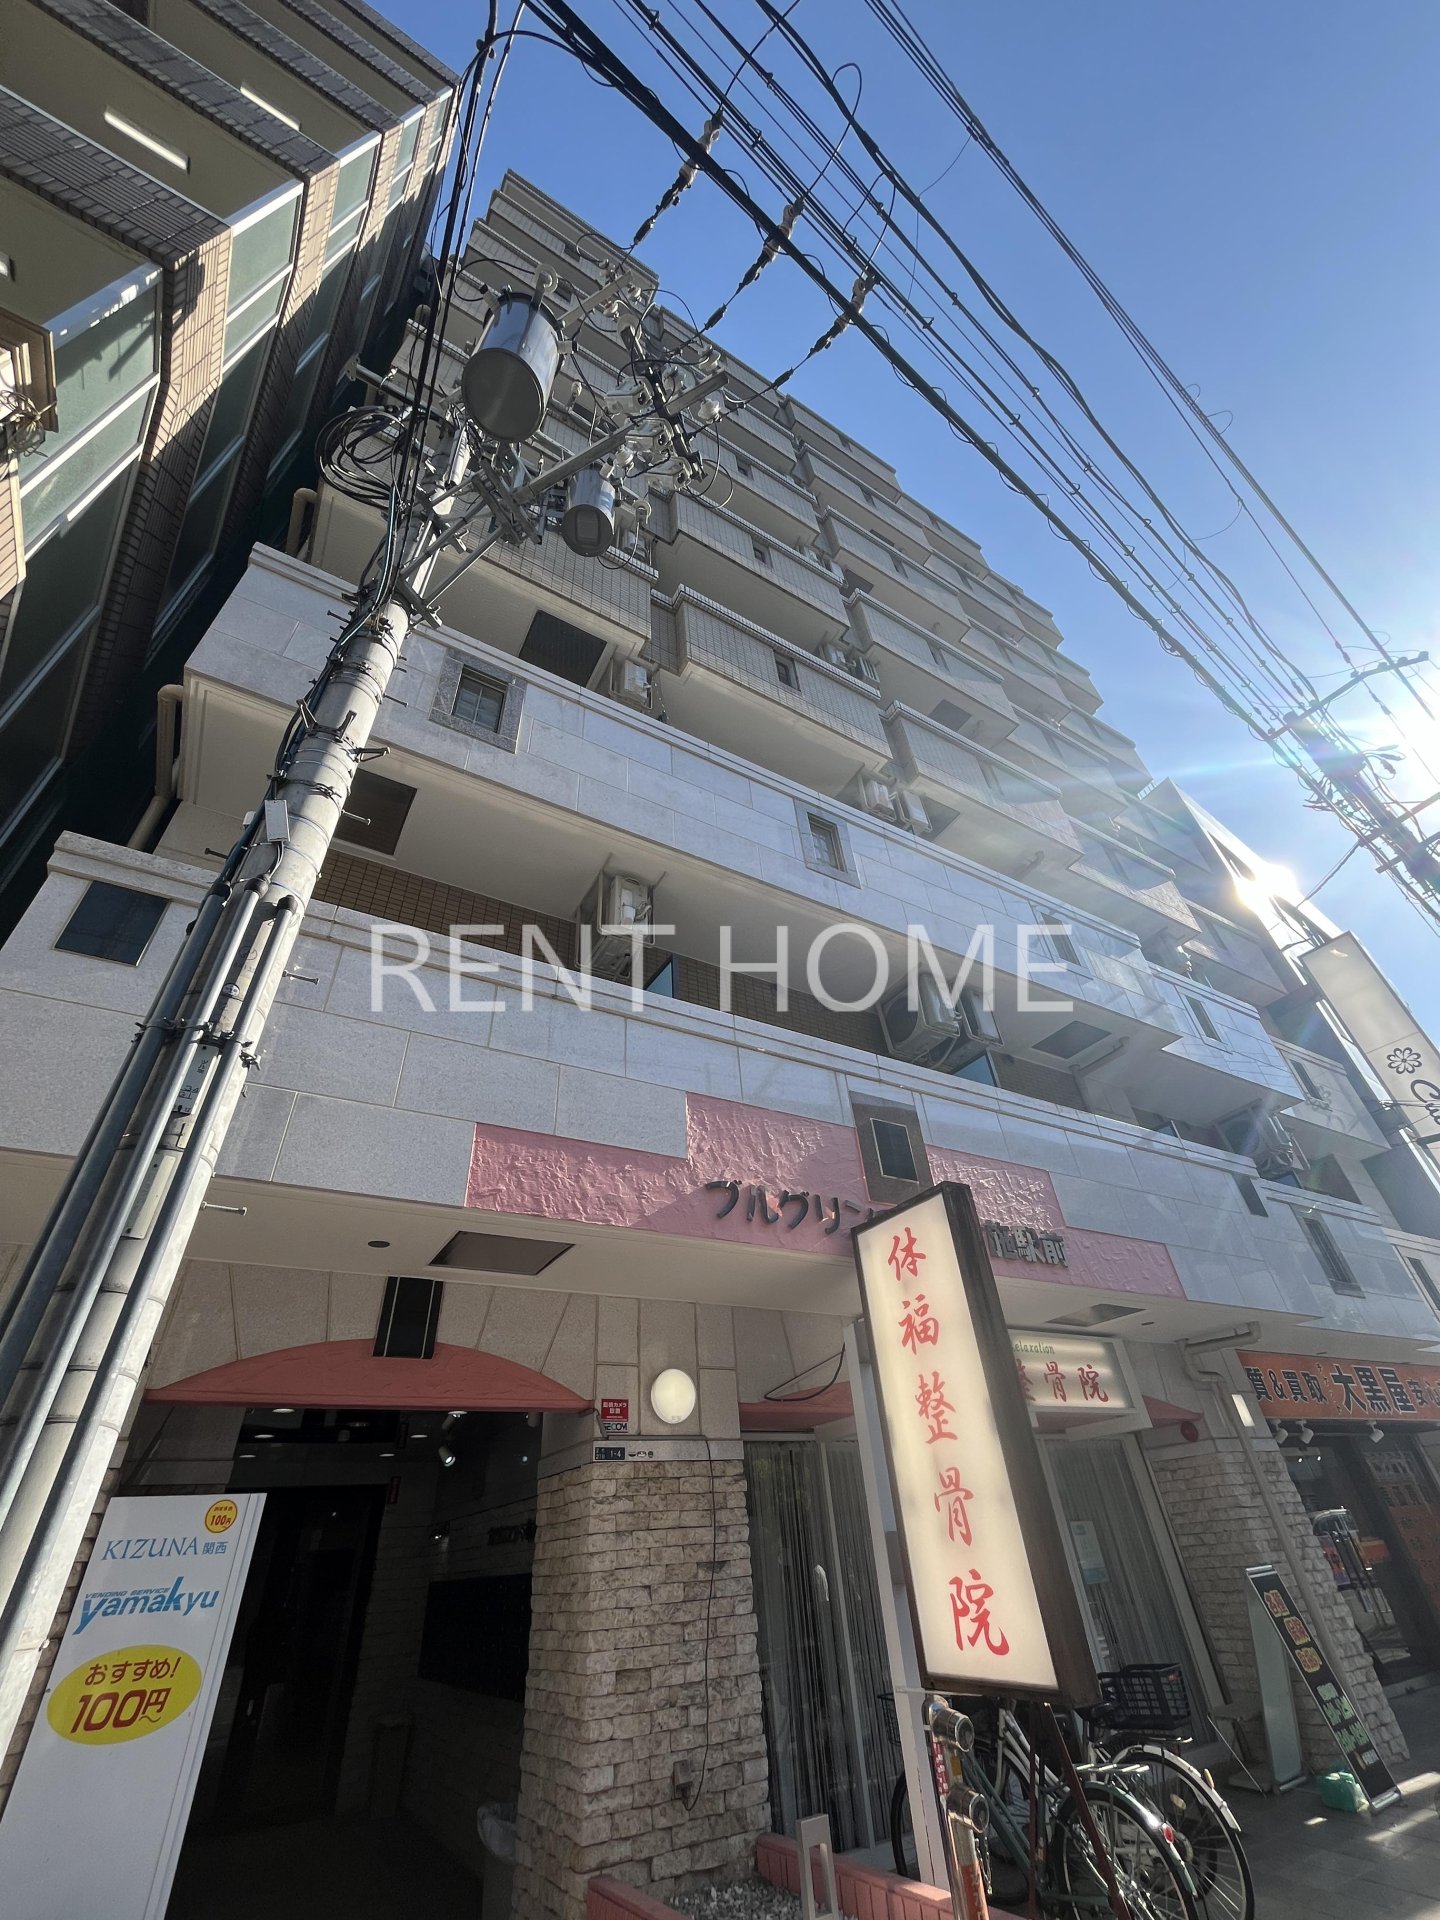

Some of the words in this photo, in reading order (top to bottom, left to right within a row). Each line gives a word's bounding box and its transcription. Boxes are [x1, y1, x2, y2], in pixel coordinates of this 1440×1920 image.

[704, 1178, 876, 1235] ブルグリ
[1013, 1340, 1056, 1355] elaxation
[1329, 1364, 1419, 1415] 大黒屋
[101, 1536, 199, 1561] KIZUNA
[202, 1541, 229, 1556] 関西
[72, 1576, 220, 1635] yamakyu
[129, 1586, 171, 1596] SERVICE
[84, 1656, 183, 1686] おすすめ!
